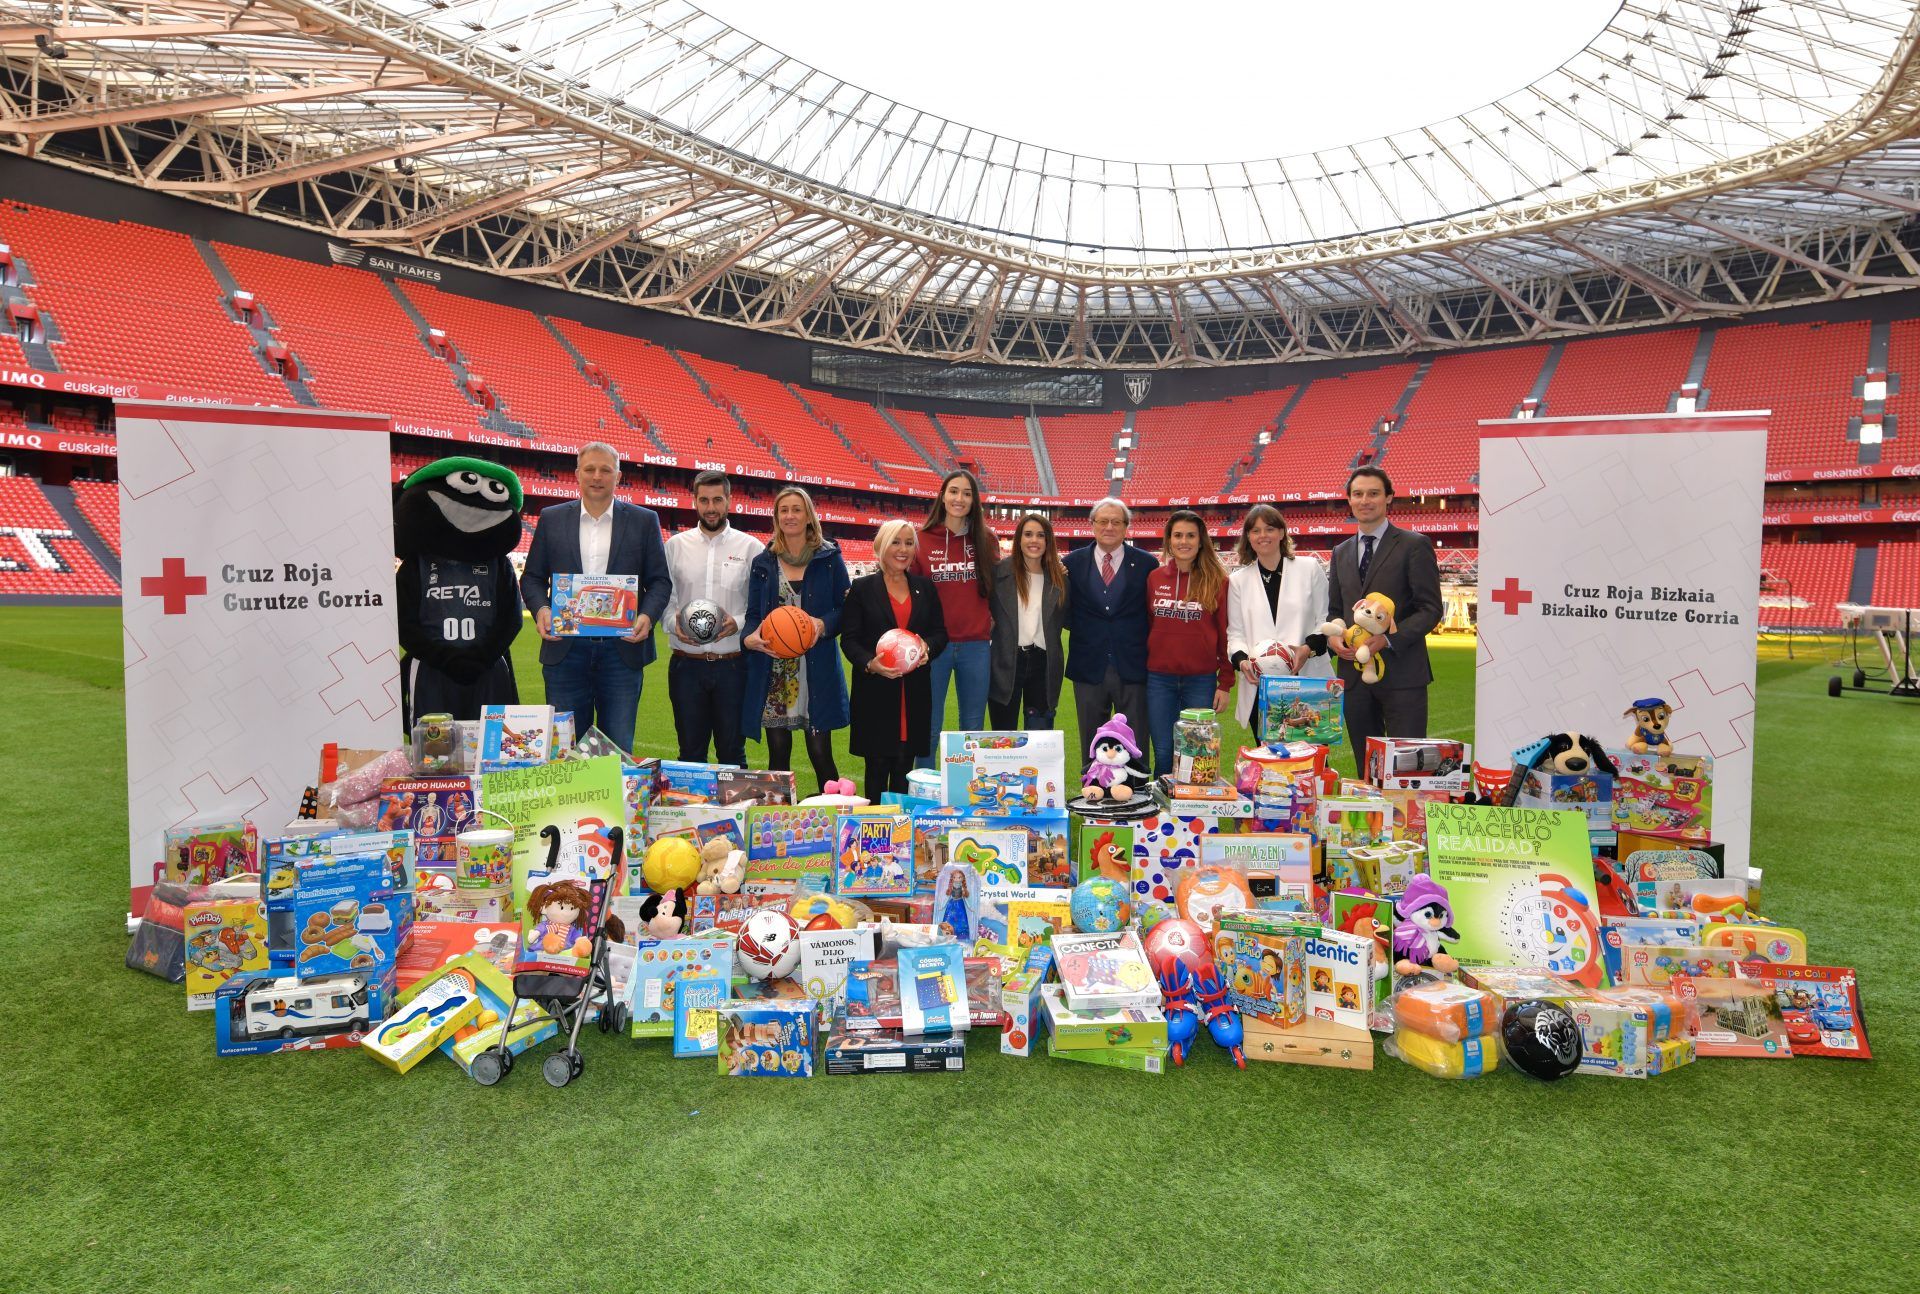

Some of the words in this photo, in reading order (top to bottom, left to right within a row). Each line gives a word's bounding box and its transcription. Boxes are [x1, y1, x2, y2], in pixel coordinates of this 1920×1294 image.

[369, 257, 395, 271] SAN
[399, 264, 442, 281] MAMES
[1, 370, 46, 388] IMQ
[64, 381, 126, 397] euskaltel
[395, 422, 454, 439] kutxabank
[0, 433, 43, 449] IMQ
[468, 432, 522, 448] kutxabank
[58, 441, 117, 456] euskalte
[530, 440, 579, 454] kutxabank
[643, 453, 678, 466] bet365
[695, 460, 726, 472] bet365
[745, 466, 776, 479] Lurauto
[794, 473, 823, 485] Lurauto
[1813, 468, 1862, 479] euskaltel
[532, 485, 580, 499] kutxabank
[1257, 494, 1276, 502] IMQ
[1282, 492, 1301, 500] IMQ
[1409, 487, 1456, 496] kutxabank
[645, 495, 678, 507] bet365
[745, 505, 774, 516] Lurauto
[1812, 512, 1862, 523] euskaltel
[1412, 522, 1459, 532] kutxabank
[221, 564, 274, 584] Cruz
[283, 563, 333, 586] Roja
[931, 570, 978, 582] GERNIK
[426, 585, 481, 604] RETA
[1563, 583, 1600, 600] Cruz
[1606, 585, 1644, 603] Roja
[1650, 586, 1716, 603] Bizkaia
[223, 592, 309, 612] Gurutze
[317, 589, 384, 609] Gorria
[465, 599, 492, 607] bet.es
[1541, 602, 1608, 619] Bizkaiko
[1614, 606, 1678, 622] Gurutze
[1685, 609, 1740, 625] Gorria
[443, 617, 476, 641] 00
[1268, 680, 1301, 689] playmobil
[944, 753, 976, 764] eduland
[488, 769, 519, 784] ZURE
[524, 760, 590, 779] LAGUNTZA
[398, 782, 429, 790] CUERPO
[430, 781, 466, 789] HUMANO
[489, 780, 530, 794] BEHAR
[536, 773, 573, 787] DUGU
[488, 786, 557, 804] EGITASMO
[490, 803, 516, 815] HAU
[521, 797, 552, 810] EGIA
[558, 788, 610, 805] BIHURTU
[490, 811, 531, 827] DADIN
[648, 810, 669, 818] prendo
[1427, 803, 1477, 821] ¿NOS
[1485, 807, 1562, 826] AYUDAS
[914, 818, 958, 827] playmobil
[862, 823, 890, 838] PARTY
[1435, 820, 1450, 835] A
[1458, 821, 1552, 841] HACERLO
[574, 845, 583, 853] 12
[1437, 834, 1542, 856] REALIDAD?
[1224, 846, 1258, 860] PIZARRA
[1259, 850, 1266, 861] 2
[1268, 847, 1281, 860] EN
[979, 889, 1009, 898] Crystal
[1011, 890, 1036, 899] World
[459, 911, 473, 919] STAR
[1558, 907, 1562, 915] 1
[1570, 922, 1577, 930] 2
[1060, 939, 1121, 954] CONECTA
[1305, 938, 1360, 966] dentic
[815, 959, 827, 967] EL
[918, 961, 945, 969] SECRETO
[919, 957, 943, 965] CÓDIGO
[1775, 967, 1801, 978] Supe
[1804, 969, 1832, 978] Color
[980, 1011, 998, 1019] TRUCK
